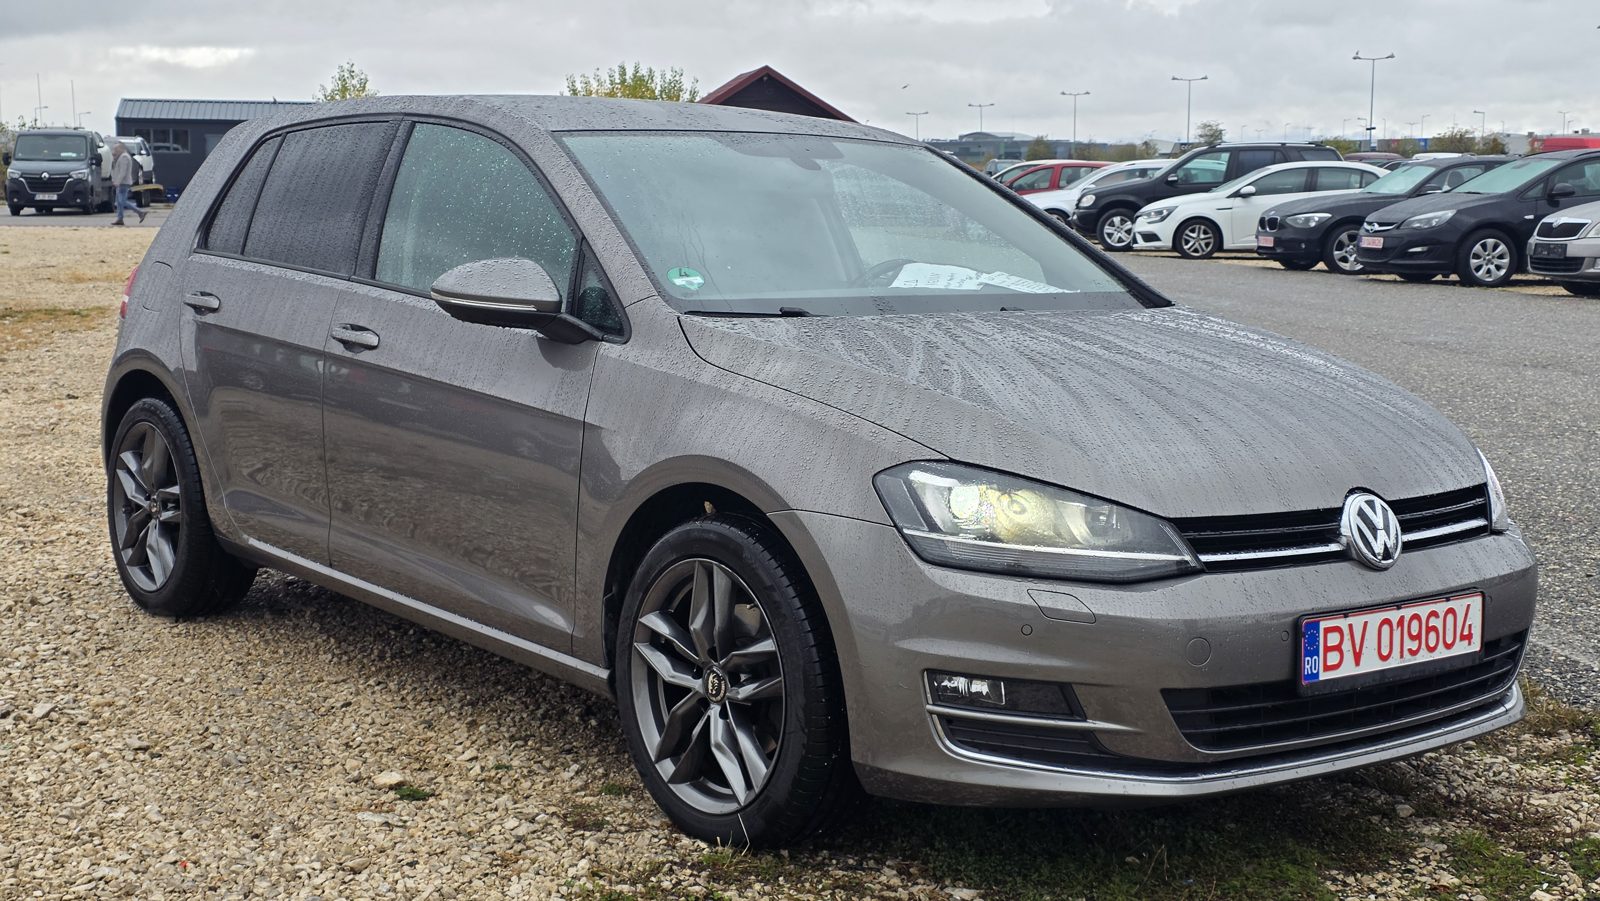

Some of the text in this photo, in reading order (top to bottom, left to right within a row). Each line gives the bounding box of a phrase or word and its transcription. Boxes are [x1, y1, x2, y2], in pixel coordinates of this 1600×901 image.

[1322, 603, 1473, 673] BV 019604
[1304, 656, 1319, 675] RO
